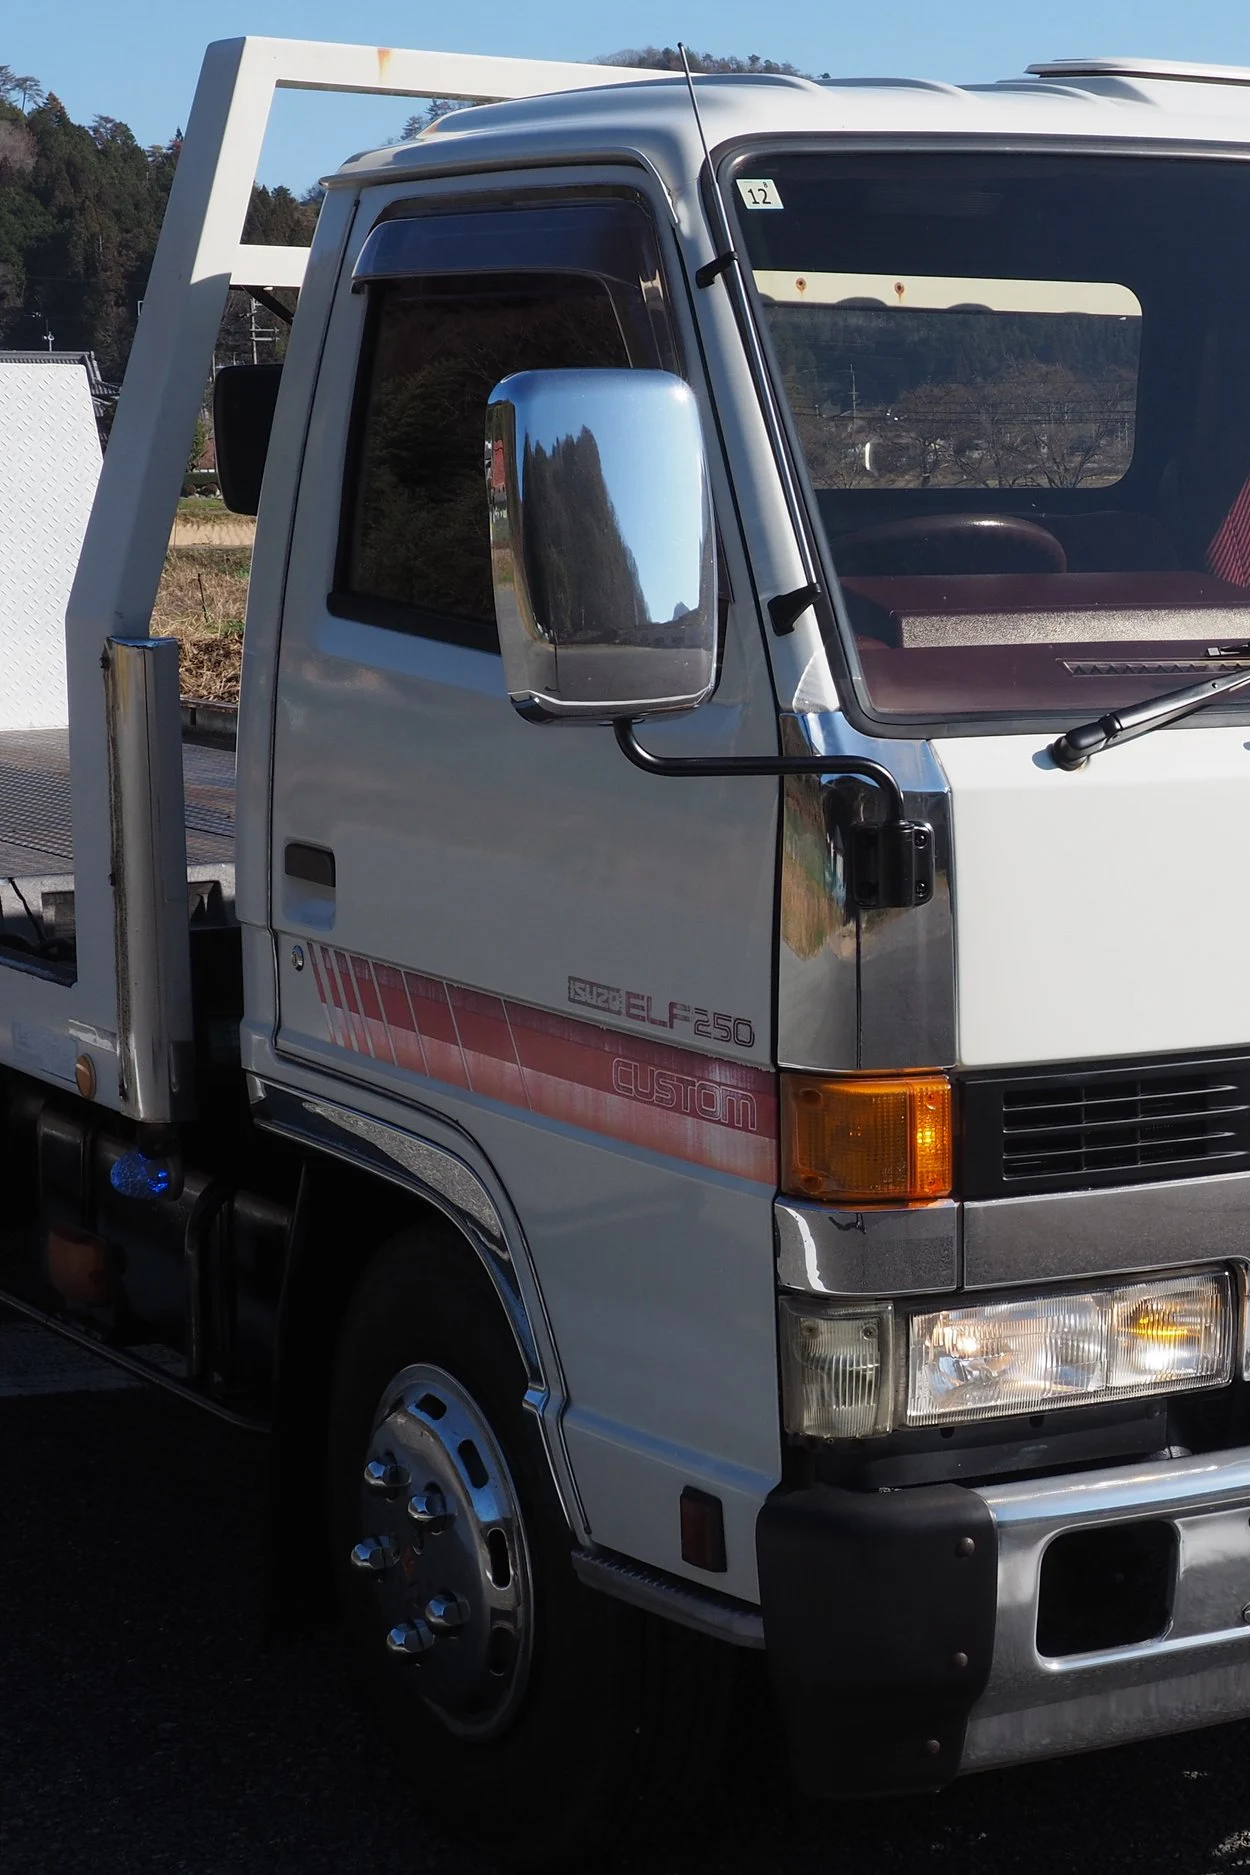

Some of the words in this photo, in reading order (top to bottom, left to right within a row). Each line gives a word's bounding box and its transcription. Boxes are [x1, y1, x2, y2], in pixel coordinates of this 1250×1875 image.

[747, 188, 772, 204] 12
[568, 977, 623, 1015] ISUZU
[612, 1057, 757, 1131] CUSTOM
